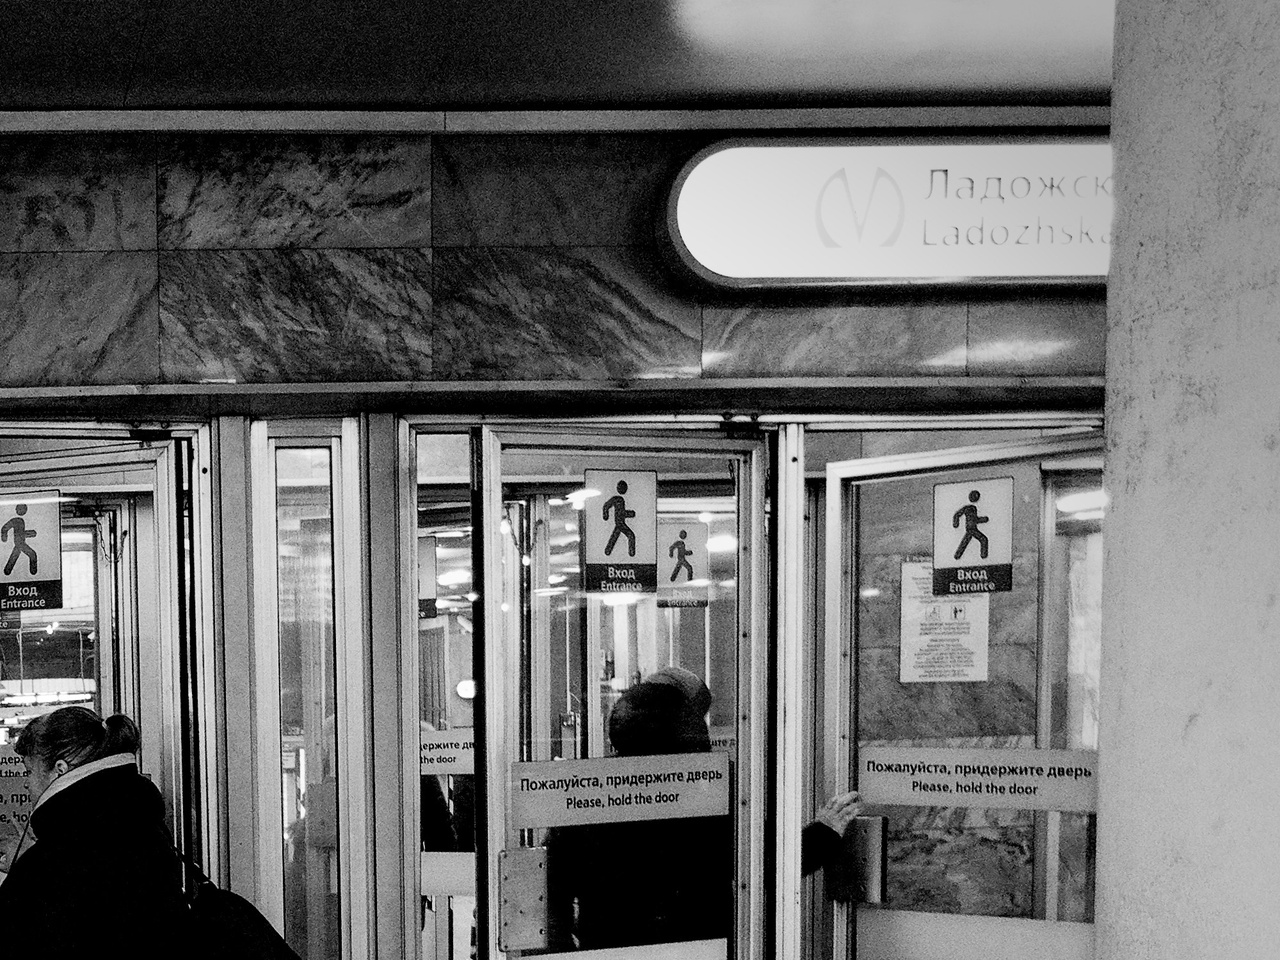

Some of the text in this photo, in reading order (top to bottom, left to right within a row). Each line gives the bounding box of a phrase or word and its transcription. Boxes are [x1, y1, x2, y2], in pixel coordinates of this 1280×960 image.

[608, 567, 635, 580] Вход
[957, 569, 988, 581] Вход
[8, 586, 38, 597] Вход
[601, 581, 643, 591] Entrance
[949, 582, 995, 593] Entrance
[1, 599, 46, 609] Entrance
[436, 755, 456, 763] door
[866, 761, 1092, 781] Пожалуйста, придержите дверь
[520, 768, 723, 792] Пожалуйста, придержите дверь
[912, 780, 1039, 795] Please, hold the door
[566, 790, 680, 809] Please, hold the door
